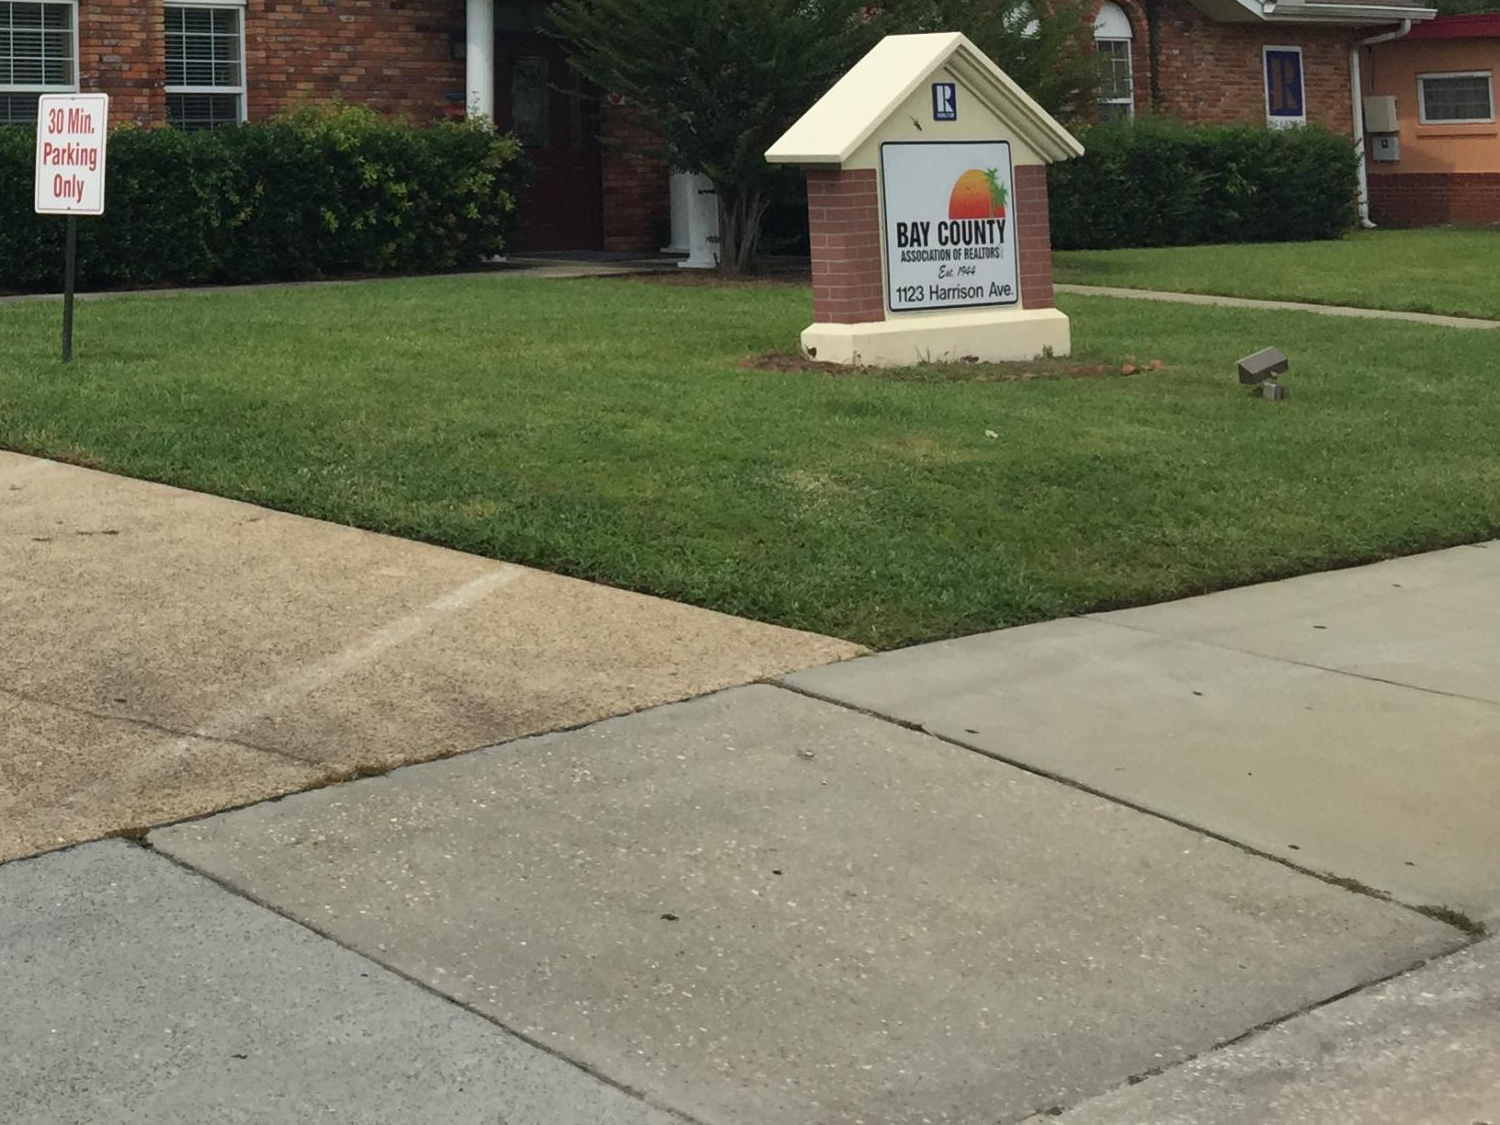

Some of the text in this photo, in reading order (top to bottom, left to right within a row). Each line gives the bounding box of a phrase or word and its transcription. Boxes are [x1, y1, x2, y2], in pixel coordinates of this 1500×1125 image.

[48, 107, 95, 134] 30 Min.
[43, 142, 97, 171] Parking
[53, 173, 84, 204] Only
[896, 218, 1006, 248] BAY COUNTY
[901, 248, 951, 263] ASSOCIATION
[953, 248, 962, 261] OF
[896, 281, 1014, 303] 1123 Harrison Ave.
